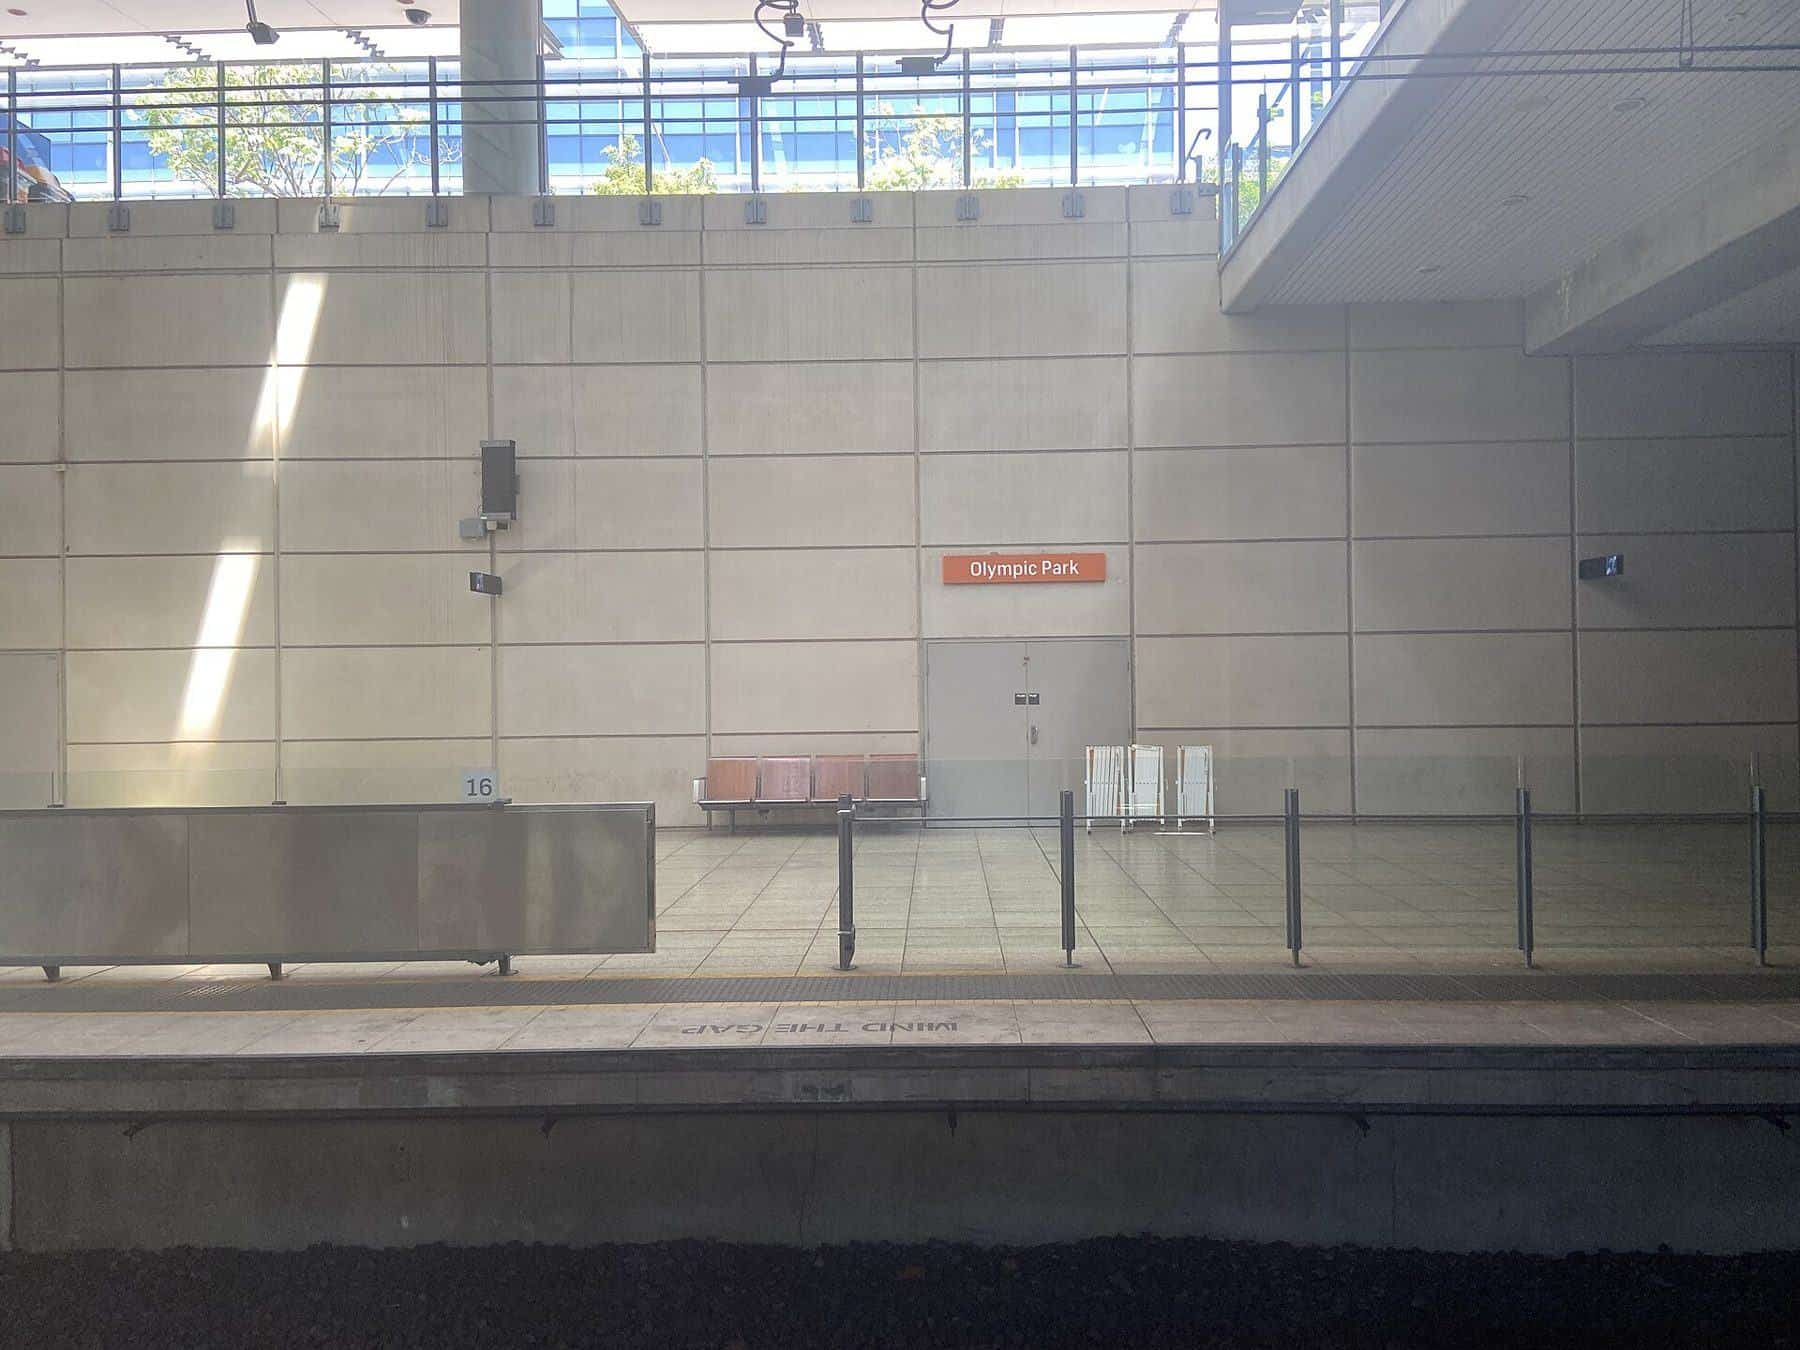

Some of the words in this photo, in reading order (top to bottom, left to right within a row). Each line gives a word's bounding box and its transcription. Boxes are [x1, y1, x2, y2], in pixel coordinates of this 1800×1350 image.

[970, 561, 1037, 579] Olympic
[1042, 560, 1079, 575] Park
[467, 778, 492, 796] 16
[682, 1023, 763, 1034] GAP
[775, 1023, 848, 1033] THE
[862, 1022, 958, 1032] MIND
